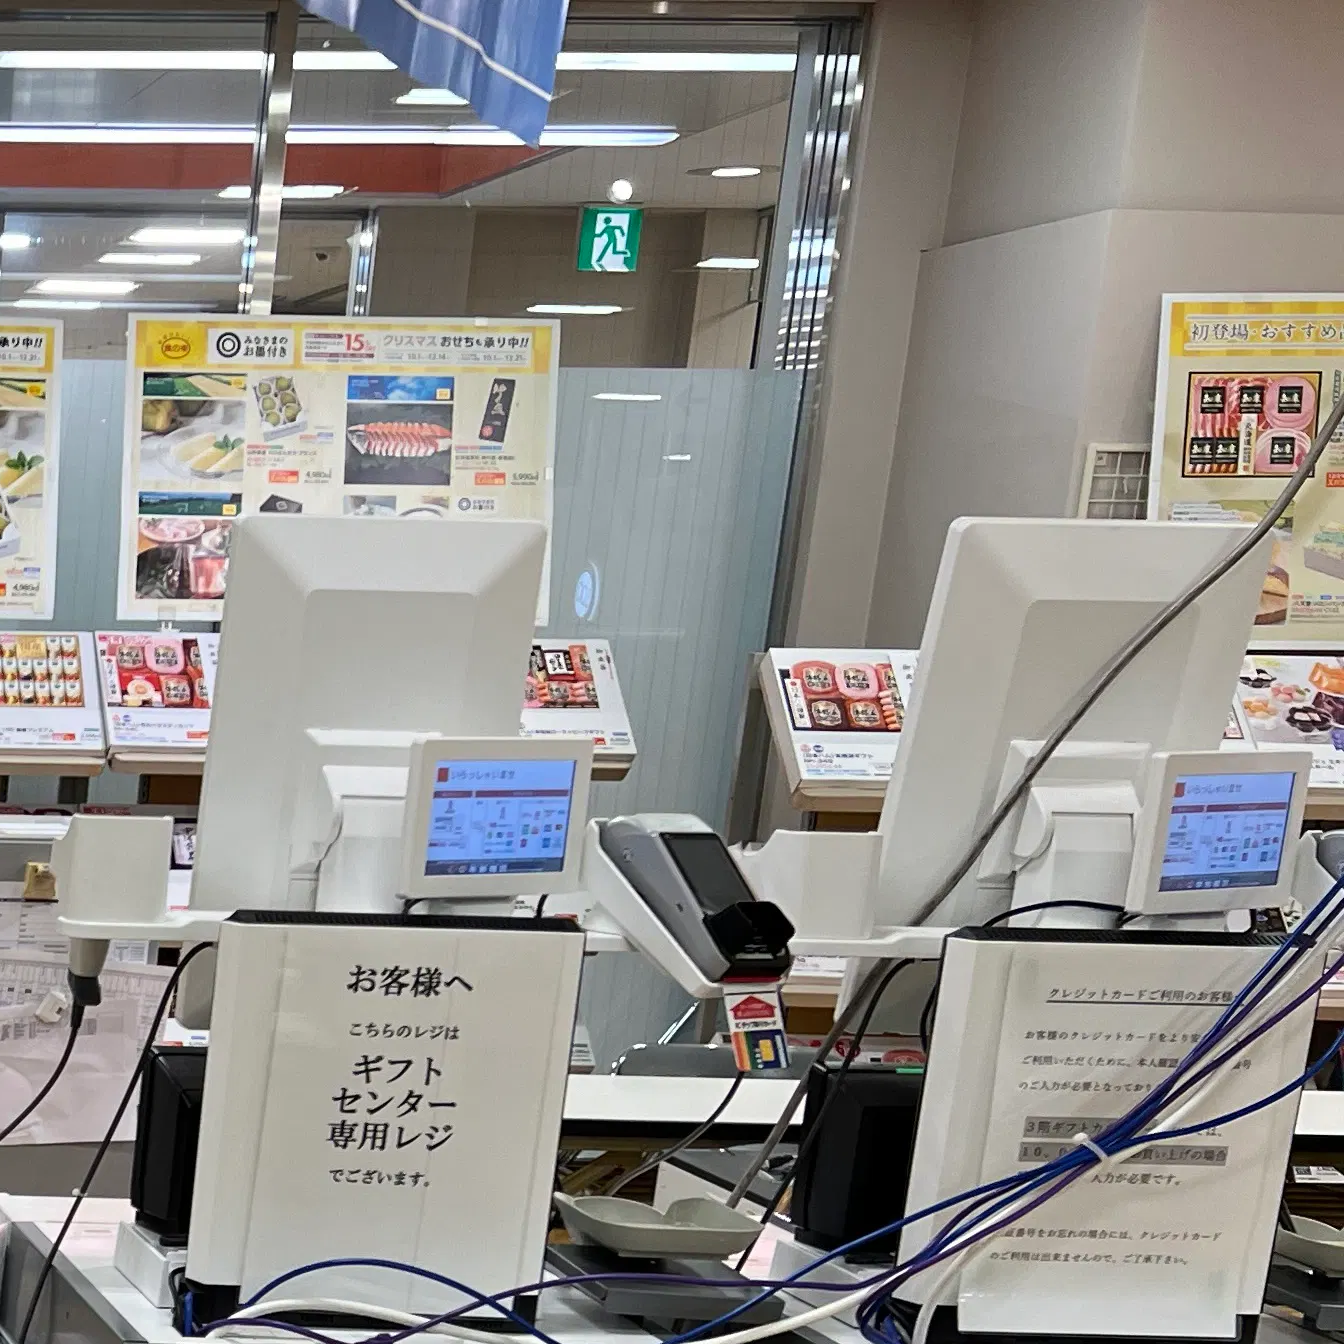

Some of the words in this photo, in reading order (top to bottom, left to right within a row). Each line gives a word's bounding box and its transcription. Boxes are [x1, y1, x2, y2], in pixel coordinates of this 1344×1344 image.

[383, 335, 438, 347] クリスマス
[1191, 322, 1344, 341] 初登場・おすすめ
[345, 334, 365, 351] 15
[346, 965, 473, 998] お客様へ
[349, 1023, 460, 1040] こちらのレジは
[352, 1055, 442, 1086] ギフト
[332, 1087, 457, 1118] センター
[326, 1119, 454, 1151] 専用レジ
[329, 1169, 430, 1188] でございます。
